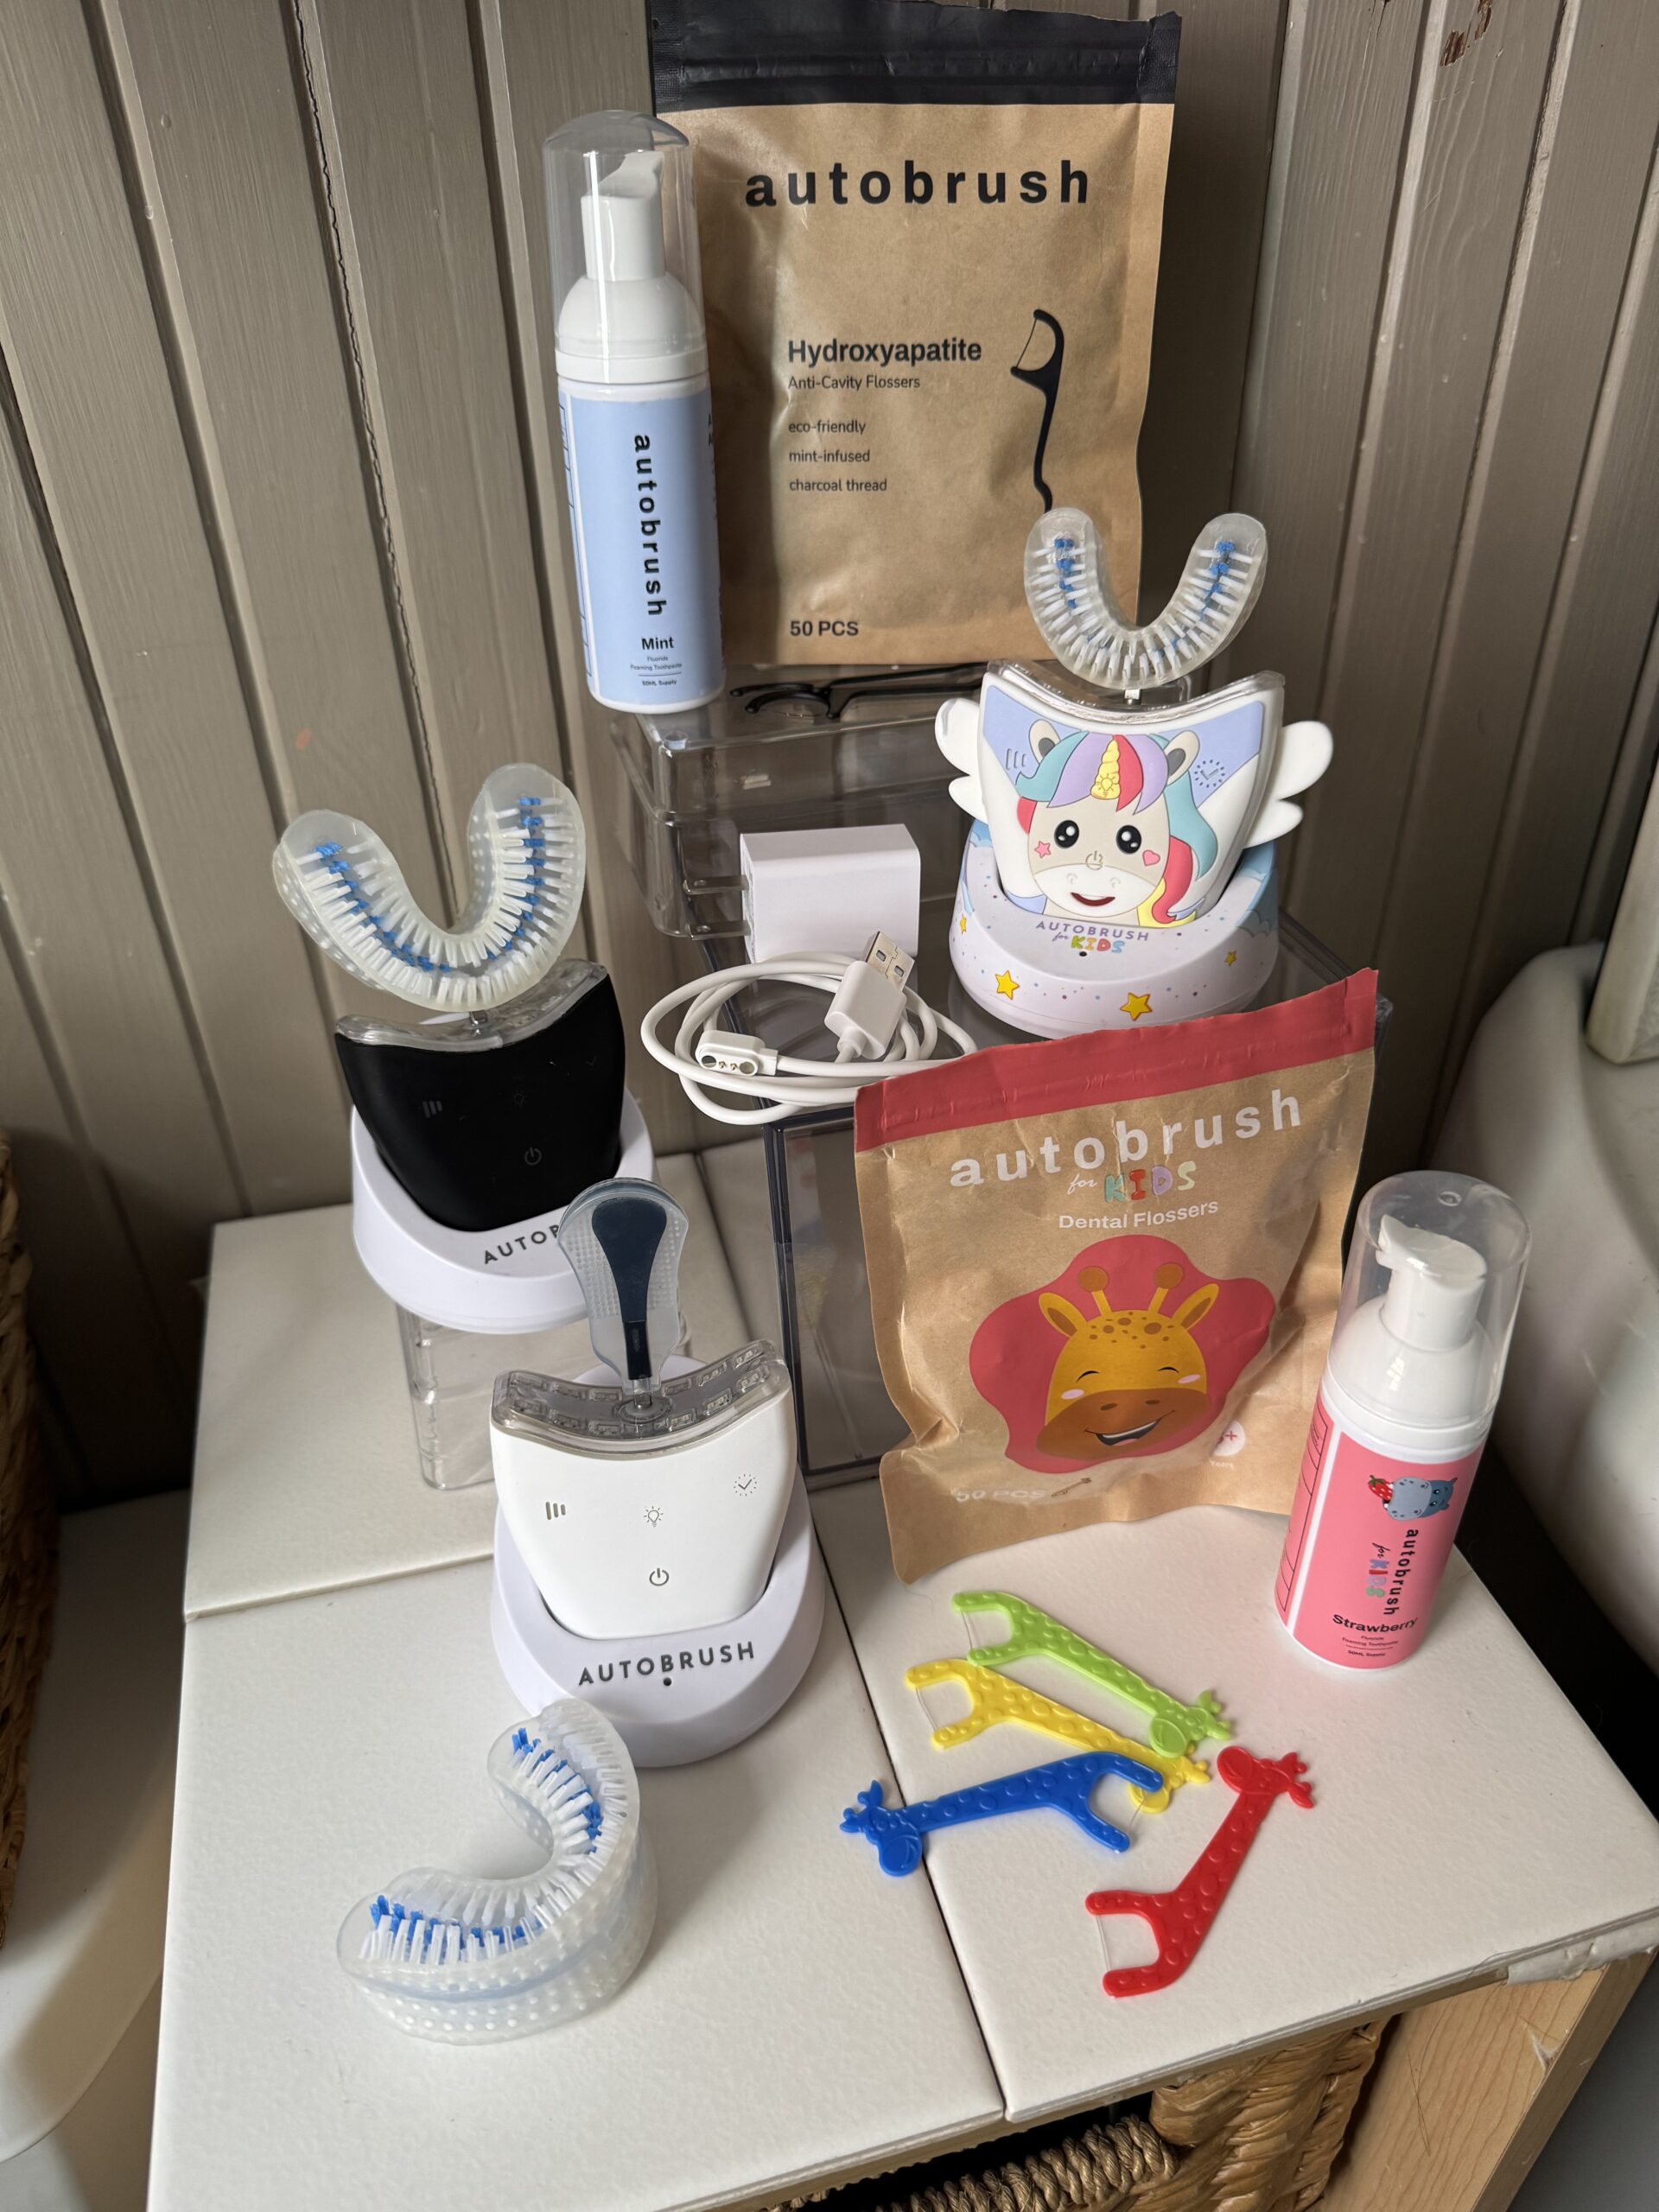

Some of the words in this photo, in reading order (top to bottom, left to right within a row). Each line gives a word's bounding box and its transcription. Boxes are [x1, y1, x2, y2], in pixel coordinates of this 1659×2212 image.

[745, 160, 1089, 208] autobrush
[788, 336, 982, 368] Hydroxyapatite
[788, 375, 862, 391] Anti-Cavity
[866, 375, 920, 388] Flossers
[788, 420, 866, 435] eco-friendly
[788, 450, 870, 462] mint-infused
[789, 479, 842, 492] charcoal
[846, 479, 887, 491] thread
[634, 435, 667, 616] autobrush
[789, 620, 814, 638] 50
[817, 620, 860, 637] PCS
[641, 636, 675, 650] Mint
[1036, 920, 1149, 941] AUTOBRUSH
[1052, 931, 1069, 942] for
[1071, 935, 1125, 954] KIDS
[950, 1088, 1302, 1189] autobrush
[1067, 1173, 1097, 1195] for
[1104, 1160, 1197, 1203] KIDS
[1058, 1213, 1128, 1229] Dental
[1134, 1200, 1218, 1227] Flossers
[1371, 1541, 1390, 1559] for
[1365, 1558, 1389, 1598] KIDS
[1383, 1529, 1420, 1615] autobrush
[1332, 1613, 1418, 1633] Strawberry
[578, 1642, 755, 1687] AUTOBRUSH
